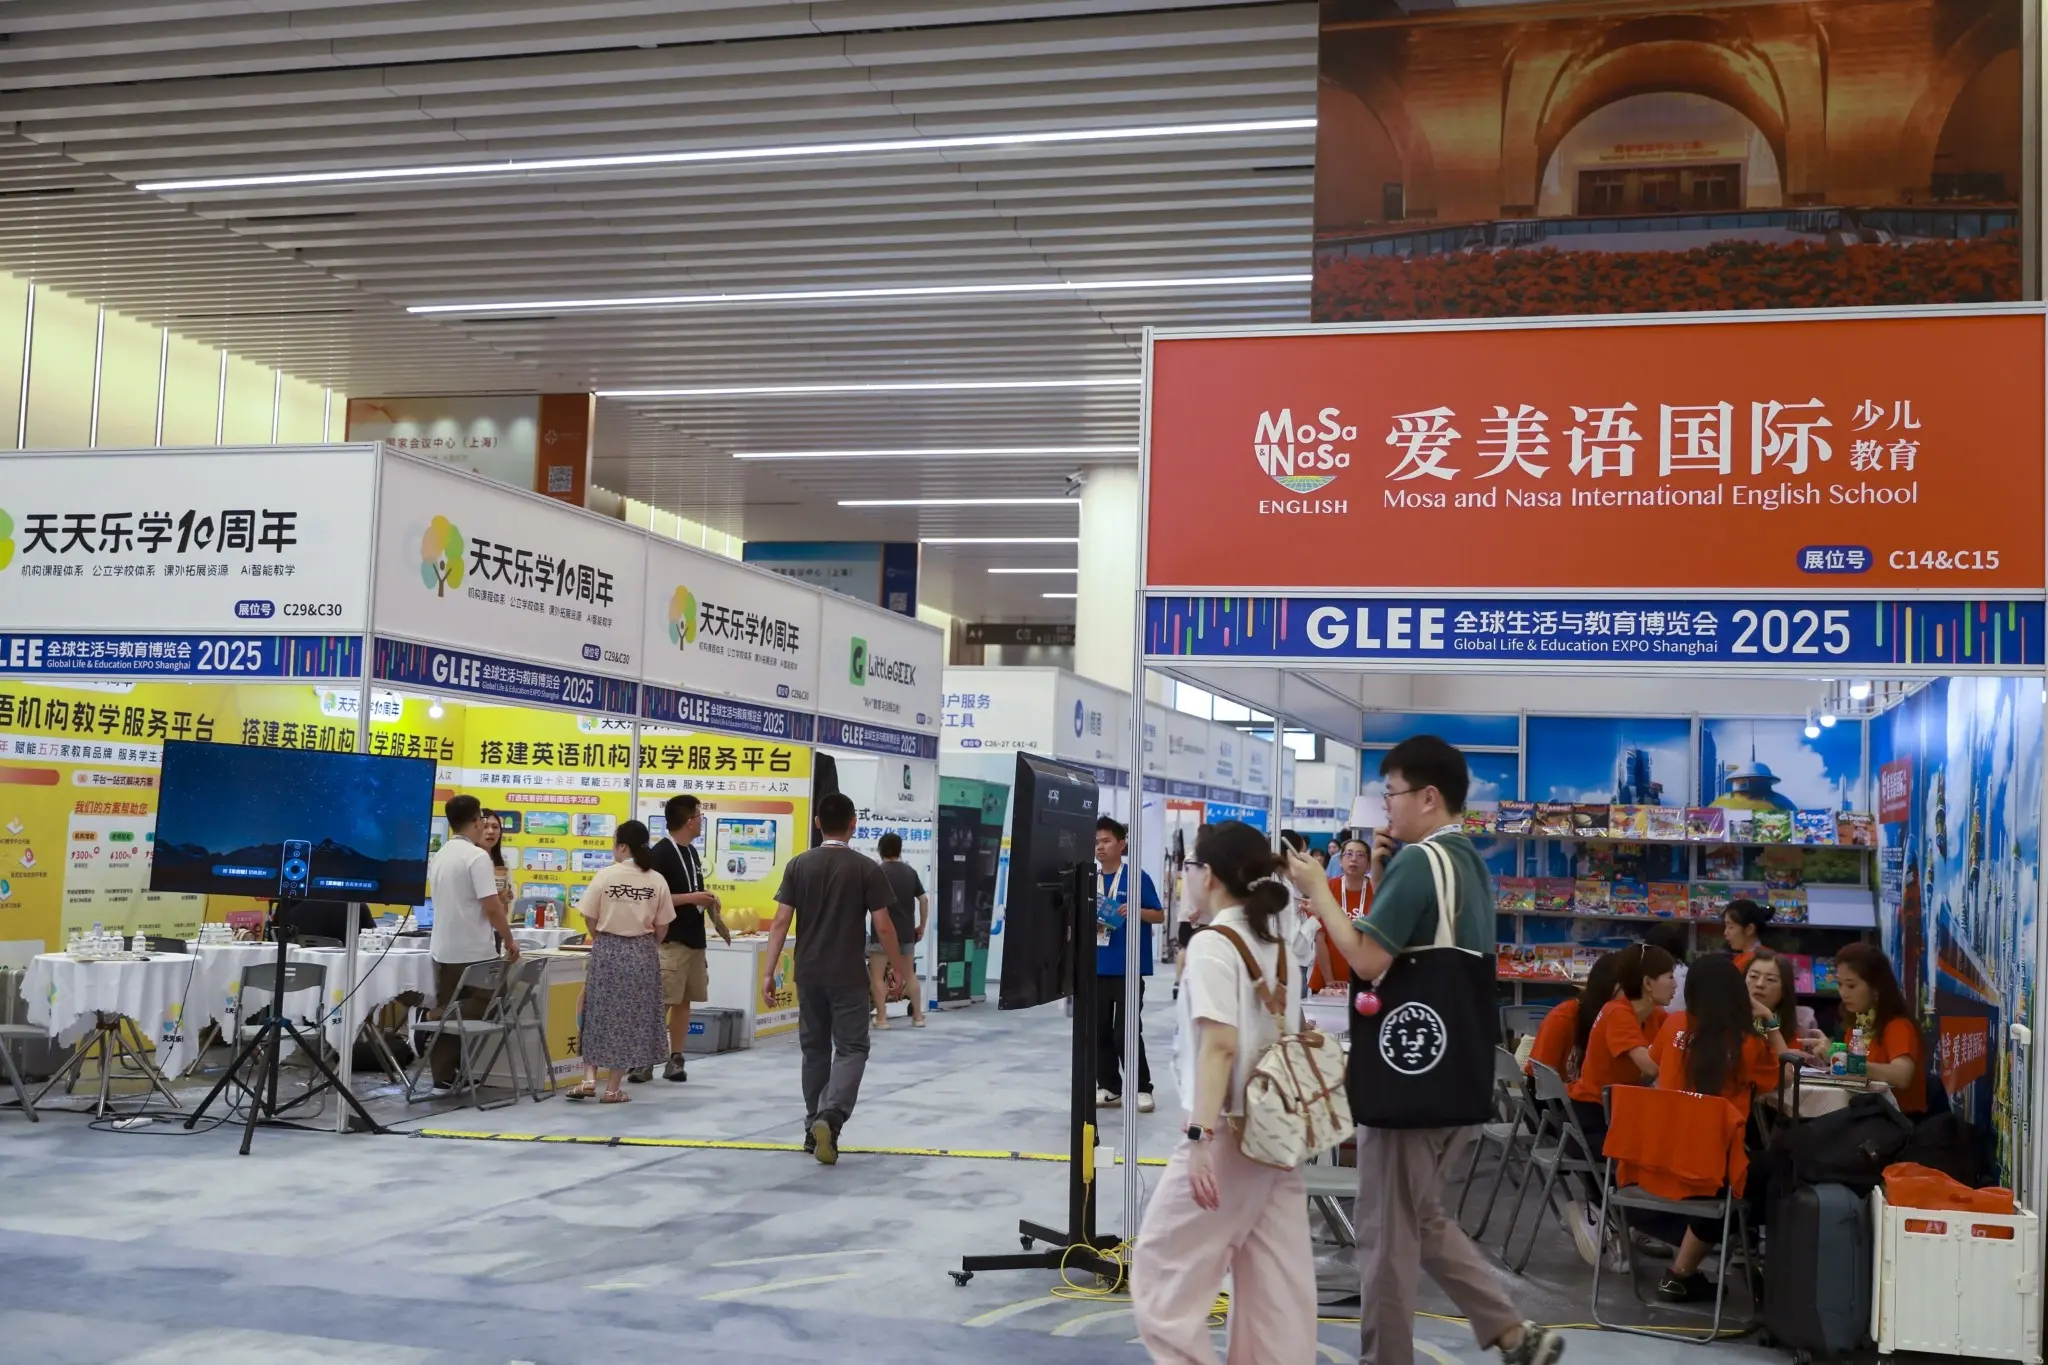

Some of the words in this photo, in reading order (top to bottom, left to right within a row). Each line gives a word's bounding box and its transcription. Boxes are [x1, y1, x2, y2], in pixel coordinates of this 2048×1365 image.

[1254, 408, 1357, 444] MoSa
[1852, 399, 1922, 432] 少儿
[1385, 397, 1832, 481] 爱美语国际
[1269, 444, 1350, 476] NaSa
[1850, 439, 1921, 471] 教育
[1258, 500, 1348, 514] ENGLISH
[1384, 490, 1446, 509] Mosa
[1454, 486, 1497, 508] and
[1505, 488, 1561, 508] Nasa
[1571, 484, 1722, 508] International
[1733, 482, 1820, 510] English
[1829, 481, 1918, 505] School
[22, 508, 298, 554] 天天乐学10周年
[20, 565, 84, 577] 机构课程体系
[92, 564, 156, 577] 公立学校体系
[164, 564, 229, 577] 课外拓展资源
[469, 537, 614, 608] 天天乐学10周年
[1804, 549, 1866, 570] 展位号
[1888, 550, 2000, 570] C14&C15
[238, 603, 272, 617] 展位号
[282, 603, 343, 617] C29&C30
[1453, 610, 1719, 638] 全球生活与教育博览会
[700, 602, 800, 655] 天天乐学10周年
[1306, 606, 1446, 650] GLEE
[1731, 609, 1851, 654] 2025
[47, 640, 192, 659] 全球生活与教育博览会
[197, 640, 262, 671] 2025
[604, 649, 630, 665] C29&C30
[1454, 637, 1496, 651] Global
[1500, 637, 1525, 651] Life
[1527, 638, 1538, 651] &
[1540, 637, 1608, 652] Education
[1612, 639, 1649, 652] EXPO
[1652, 638, 1718, 657] Shanghai
[47, 659, 71, 668] Global
[72, 659, 86, 668] Life
[87, 660, 93, 668] &
[94, 660, 132, 669] Education
[133, 660, 154, 669] EXPO
[155, 660, 191, 672] Shanghai
[432, 654, 481, 688] GLEE
[482, 664, 561, 690] 全球生活与教育博览会
[868, 653, 917, 687] LittleGEEK
[562, 675, 595, 705] 2025
[941, 693, 991, 709] 户服务
[679, 696, 710, 724] GLEE
[763, 711, 785, 735] 2025
[841, 723, 864, 746] GLEE
[900, 734, 917, 754] 2025
[15, 741, 113, 760] 赋能五万家教育品牌
[480, 740, 792, 773] 搭建英语机构教学服务平台
[93, 774, 154, 788] 平台一站式解决方案
[480, 773, 577, 786] 深耕教育行业十余年
[75, 800, 149, 816] 我们的方案帮助您
